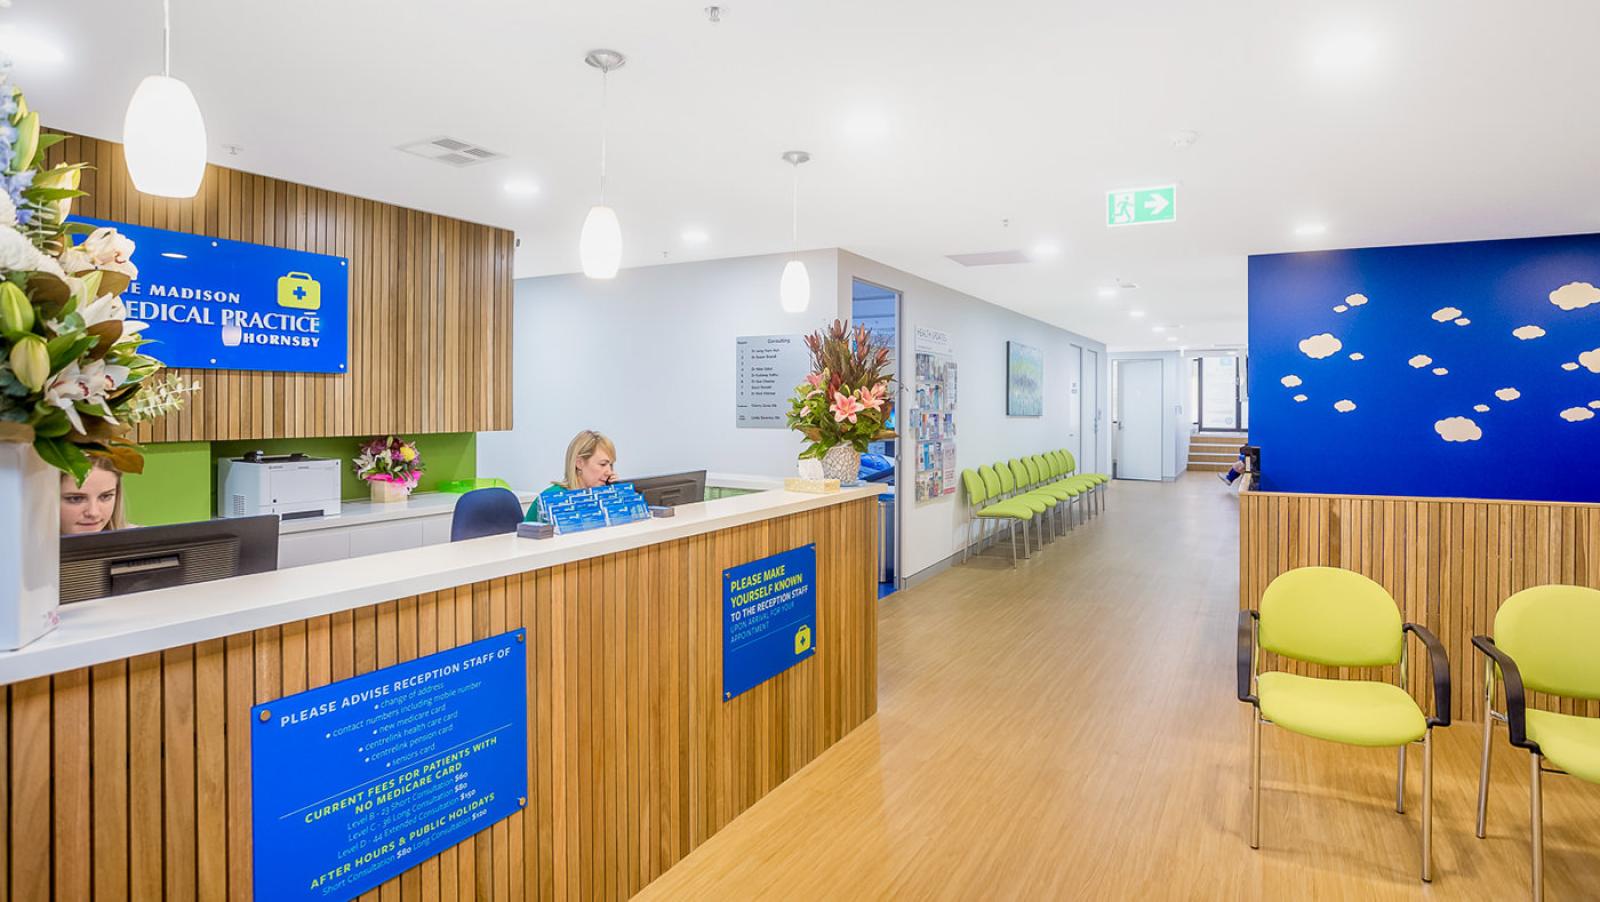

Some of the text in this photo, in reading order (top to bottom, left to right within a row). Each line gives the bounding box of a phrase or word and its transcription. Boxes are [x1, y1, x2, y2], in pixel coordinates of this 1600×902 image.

[149, 284, 241, 304] MADISON
[126, 300, 320, 333] EDICAL PRACTICE
[242, 332, 320, 348] HORNSBY
[730, 565, 786, 593] PLEASE MAKE
[730, 573, 803, 608] YOURSELF KNOWN
[730, 584, 808, 622] TO THE RECEPTION STAFF
[280, 646, 512, 728] PLEASE ADVISE RECEPTION STAFF OF
[380, 682, 445, 709] change of address
[332, 681, 482, 738] contact numbers including mobile number
[379, 704, 446, 734] new medicare card
[364, 710, 458, 752] centrelink health care card
[370, 724, 454, 762] centrelink pension card
[392, 744, 436, 767] seniors card
[304, 736, 497, 824] CURRENT FEES FOR PATIENTS WITH
[354, 762, 462, 815] NO MEDICARE CARD
[346, 816, 368, 830] Level
[369, 812, 376, 820] B
[381, 807, 390, 816] 23
[390, 797, 410, 810] Short
[412, 778, 454, 803] Consultation
[454, 772, 469, 783] $60
[348, 827, 368, 842] Level
[370, 823, 376, 832] C
[392, 809, 412, 823] Long
[412, 789, 454, 813] Consultation
[454, 782, 469, 794] $80
[310, 792, 496, 890] AFTER HOURS & PUBLIC HOLIDAYS
[337, 844, 359, 860] Level
[360, 840, 368, 849] D
[372, 834, 383, 843] 44
[384, 817, 418, 837] Extended
[418, 797, 460, 820] Consultation
[459, 789, 477, 801] $150
[322, 808, 488, 896] Short Consultation $80 Long Consultation $120
